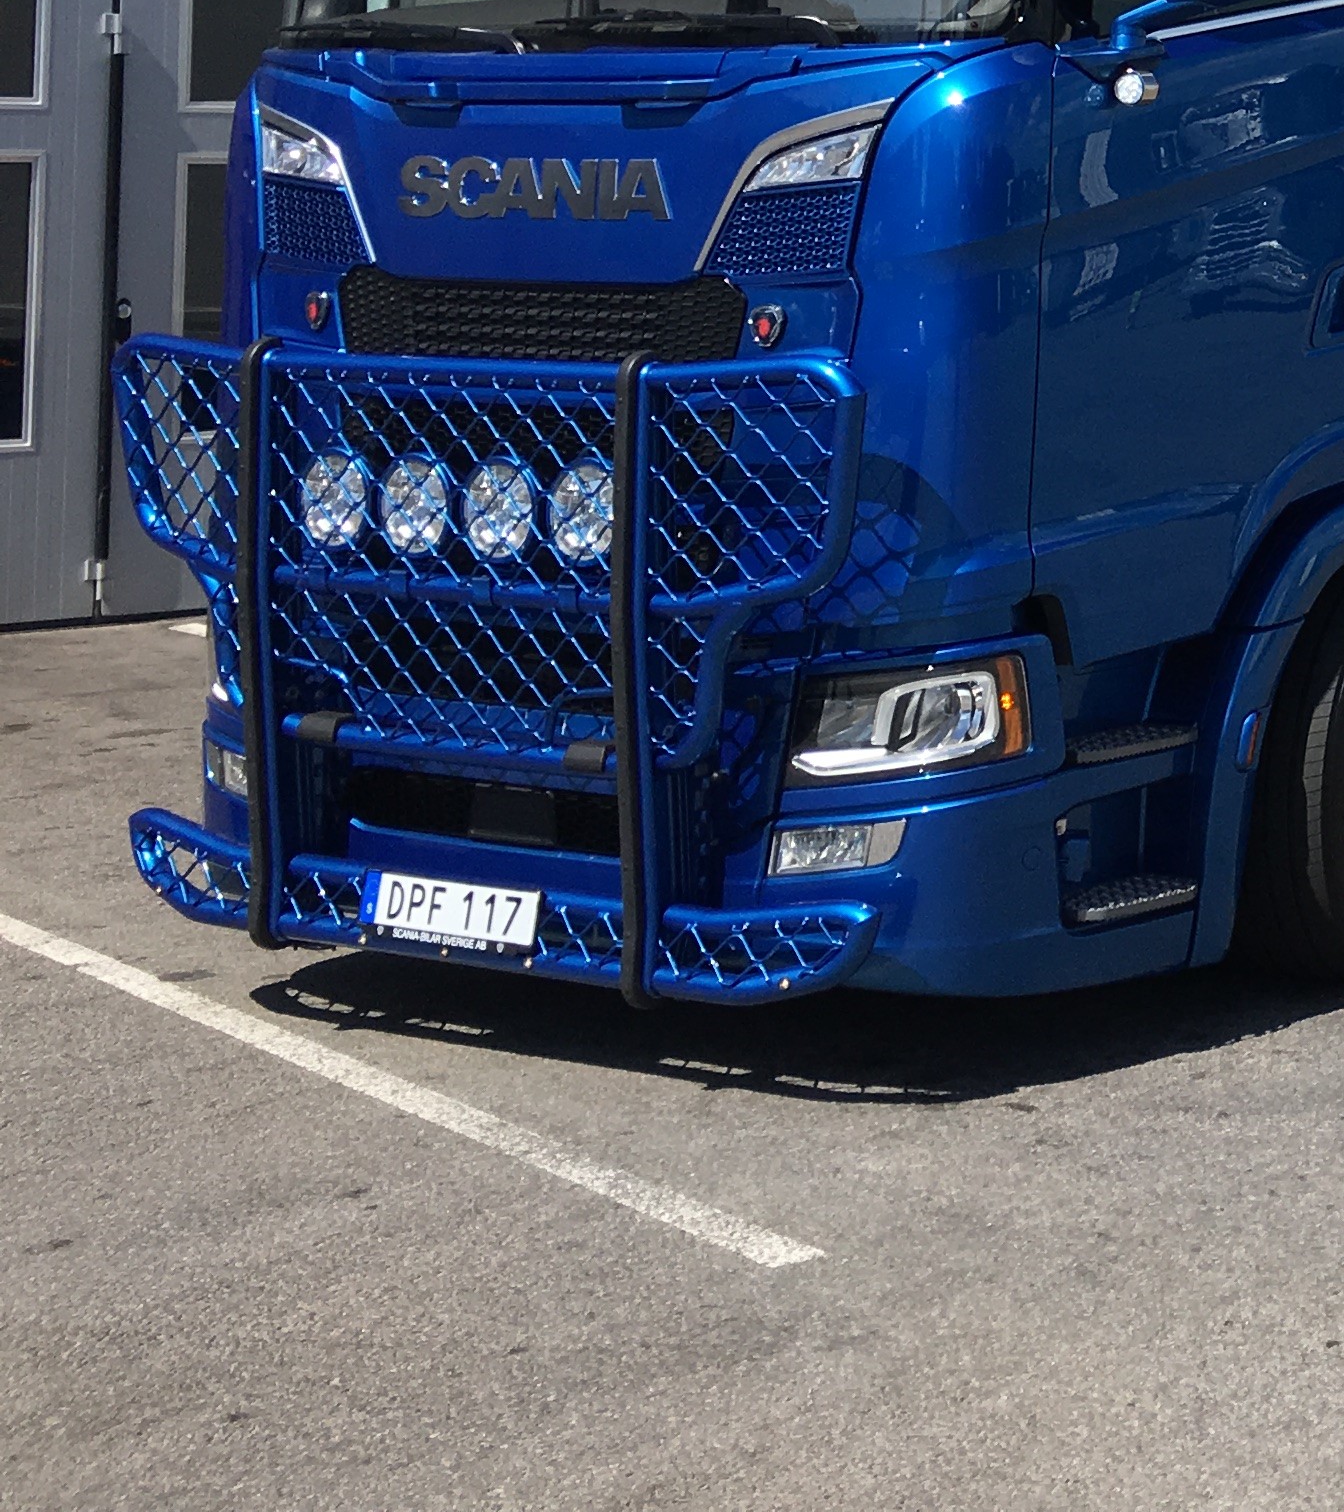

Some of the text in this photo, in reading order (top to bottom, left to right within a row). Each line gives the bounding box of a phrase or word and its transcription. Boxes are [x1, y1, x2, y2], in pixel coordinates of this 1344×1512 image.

[399, 154, 672, 220] SCANIA
[386, 880, 522, 936] DPF 117
[392, 928, 486, 950] SCANIA-BILAR SVERIGE AB
